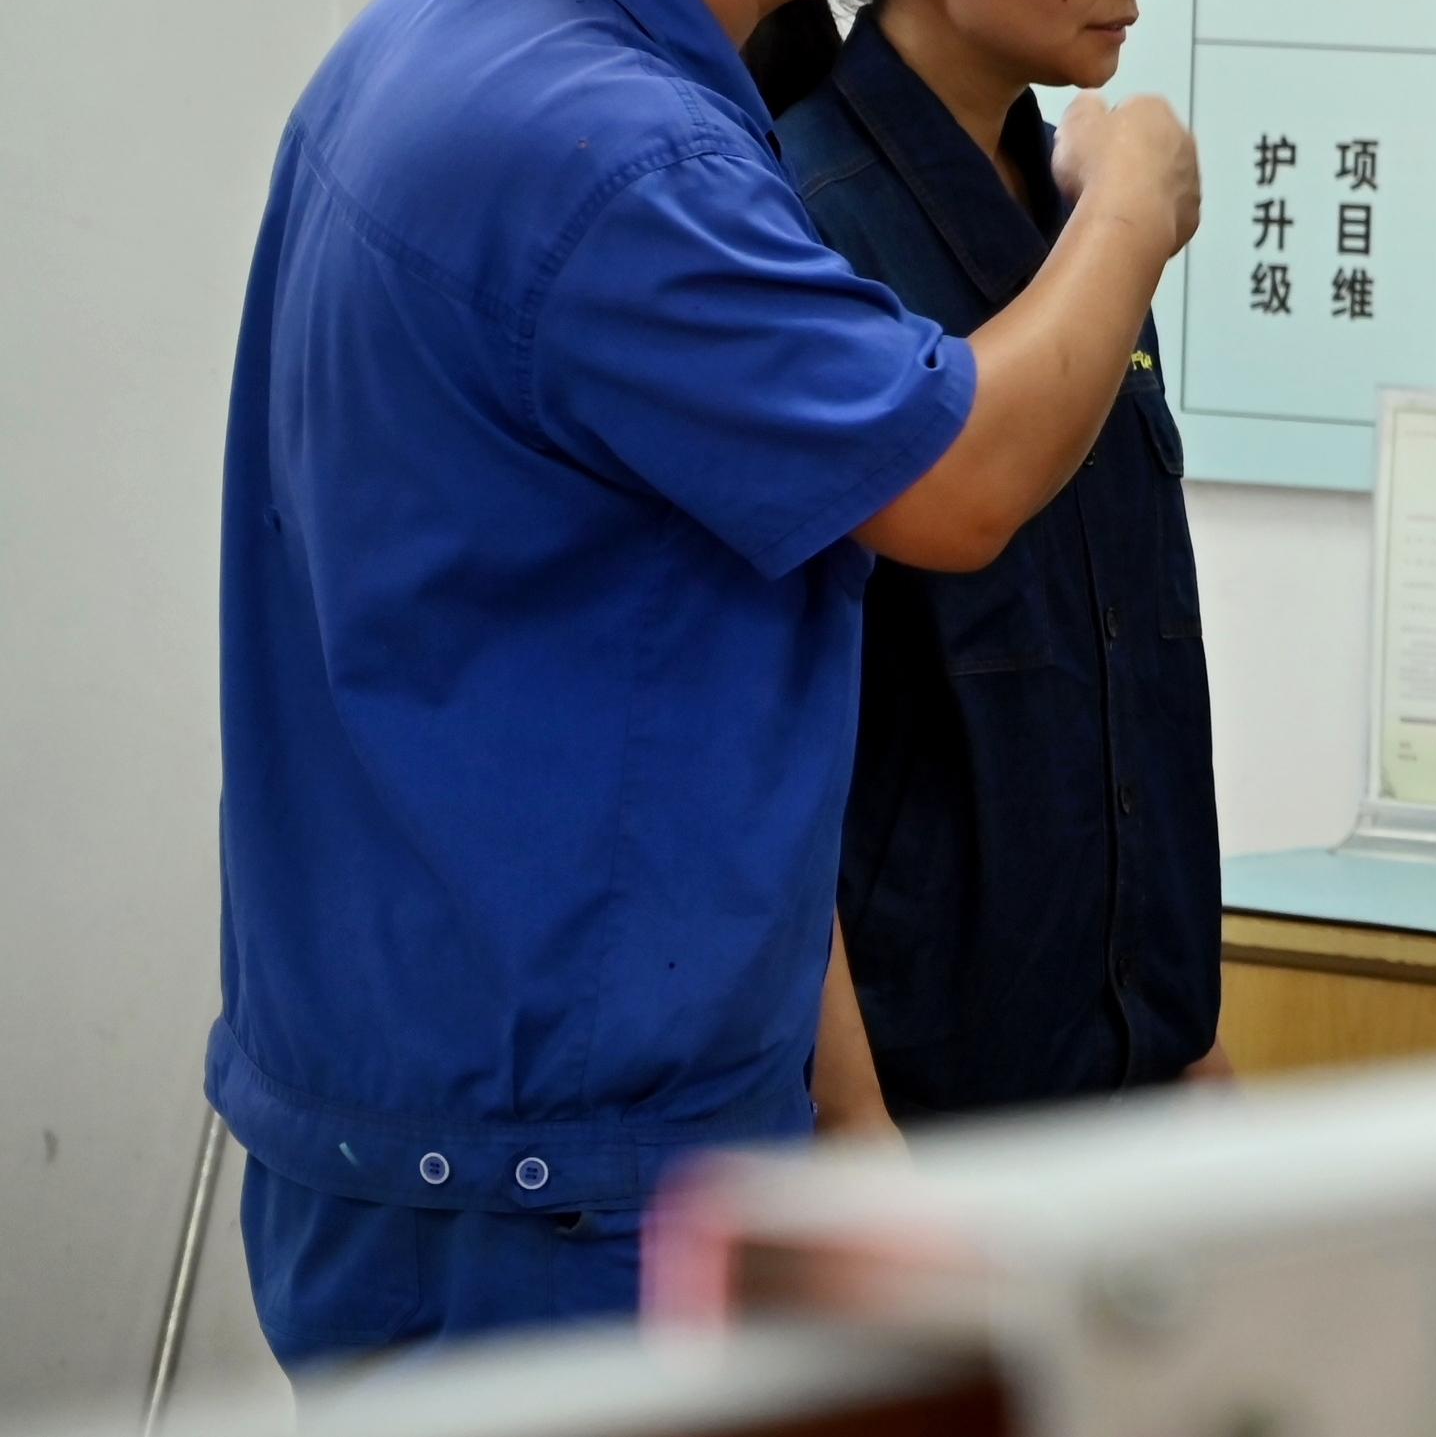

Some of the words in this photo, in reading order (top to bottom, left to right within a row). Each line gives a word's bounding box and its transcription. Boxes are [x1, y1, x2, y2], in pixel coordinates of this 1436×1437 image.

[1249, 133, 1298, 317] 护升级
[1330, 137, 1381, 322] 项目维
